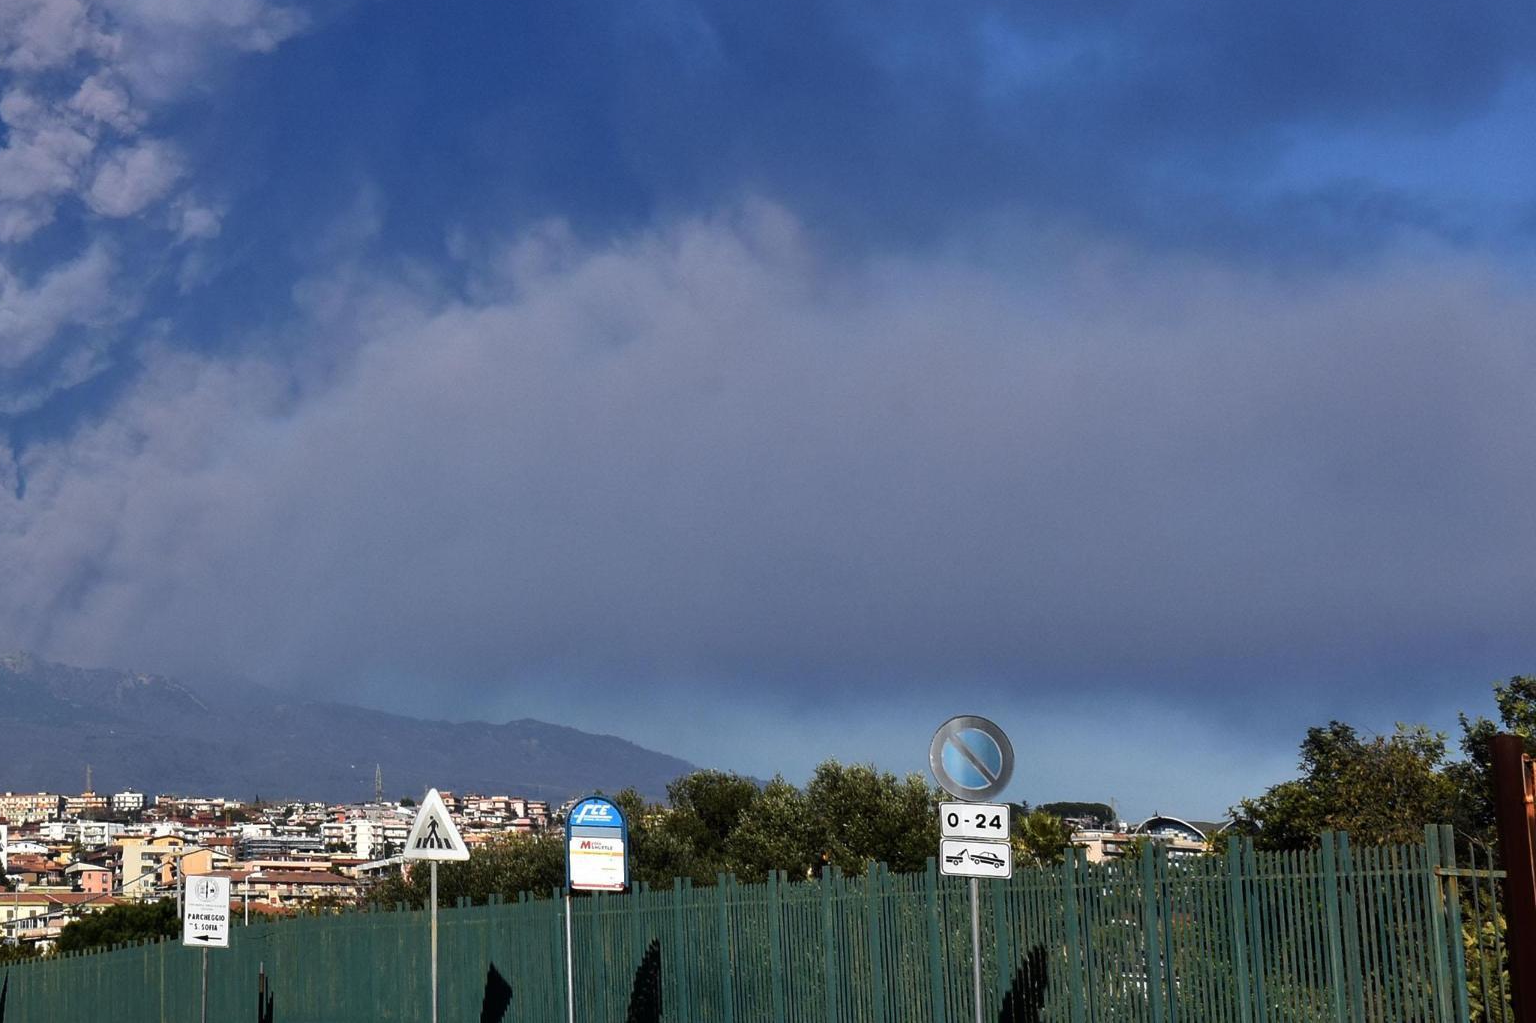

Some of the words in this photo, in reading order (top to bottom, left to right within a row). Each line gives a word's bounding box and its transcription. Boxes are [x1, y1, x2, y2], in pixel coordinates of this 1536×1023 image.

[947, 812, 959, 828] 0
[975, 813, 1002, 830] 24
[187, 913, 226, 922] PARCHEGGIO
